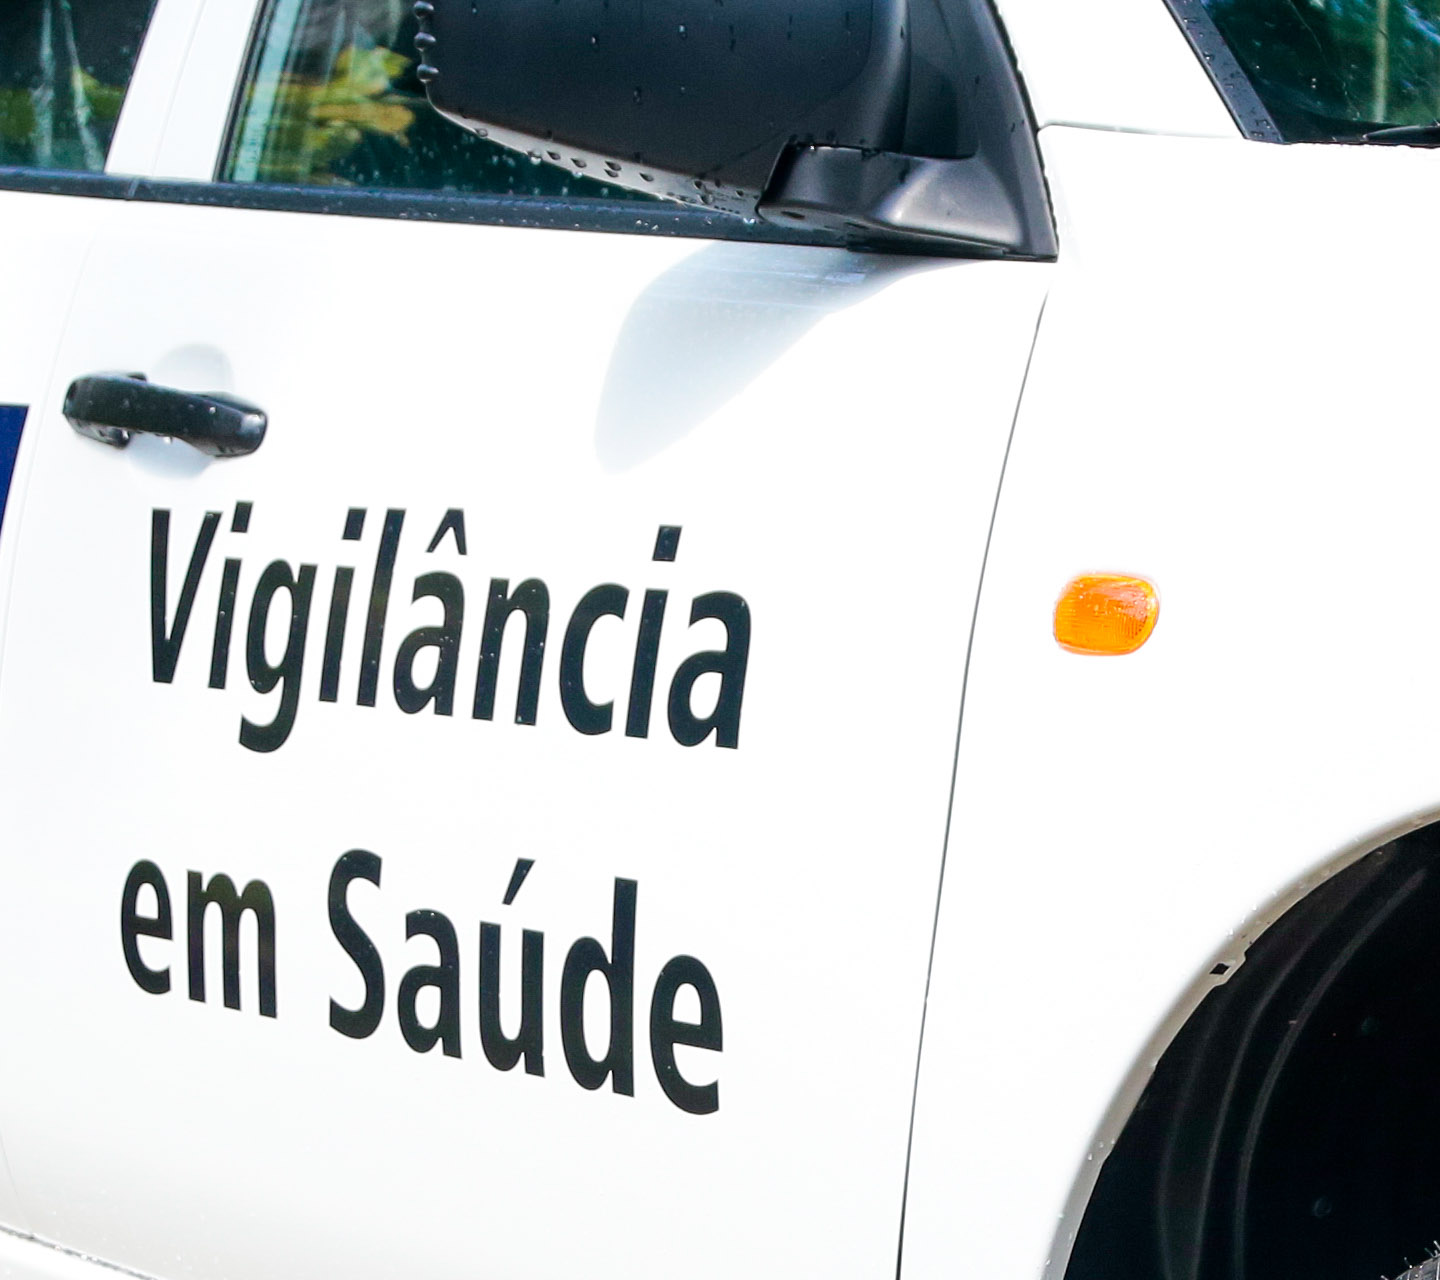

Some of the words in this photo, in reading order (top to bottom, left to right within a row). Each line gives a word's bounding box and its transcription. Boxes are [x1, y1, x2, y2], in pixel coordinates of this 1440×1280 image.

[151, 500, 753, 754] Vigilância
[120, 859, 278, 1019] em
[327, 848, 724, 1116] Saúde
